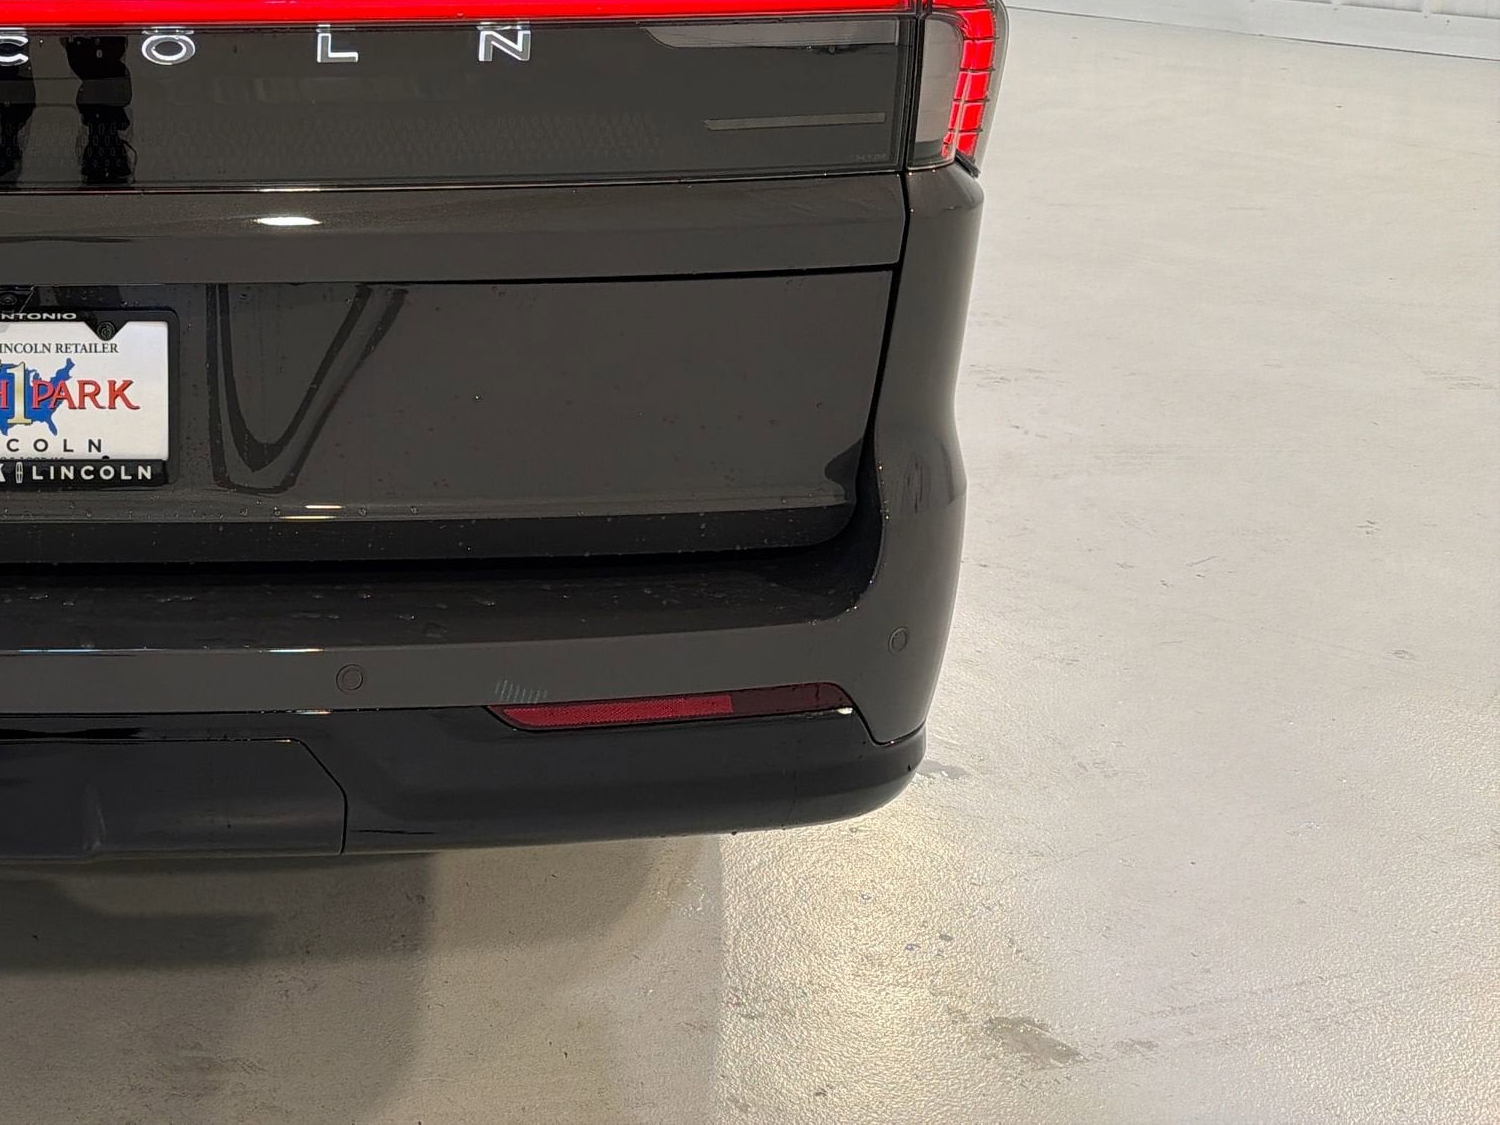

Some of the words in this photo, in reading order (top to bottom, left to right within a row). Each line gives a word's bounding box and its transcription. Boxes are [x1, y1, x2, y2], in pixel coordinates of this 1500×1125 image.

[55, 342, 119, 355] RETAILER
[31, 379, 140, 411] PARK
[31, 465, 152, 481] LINCOLN
